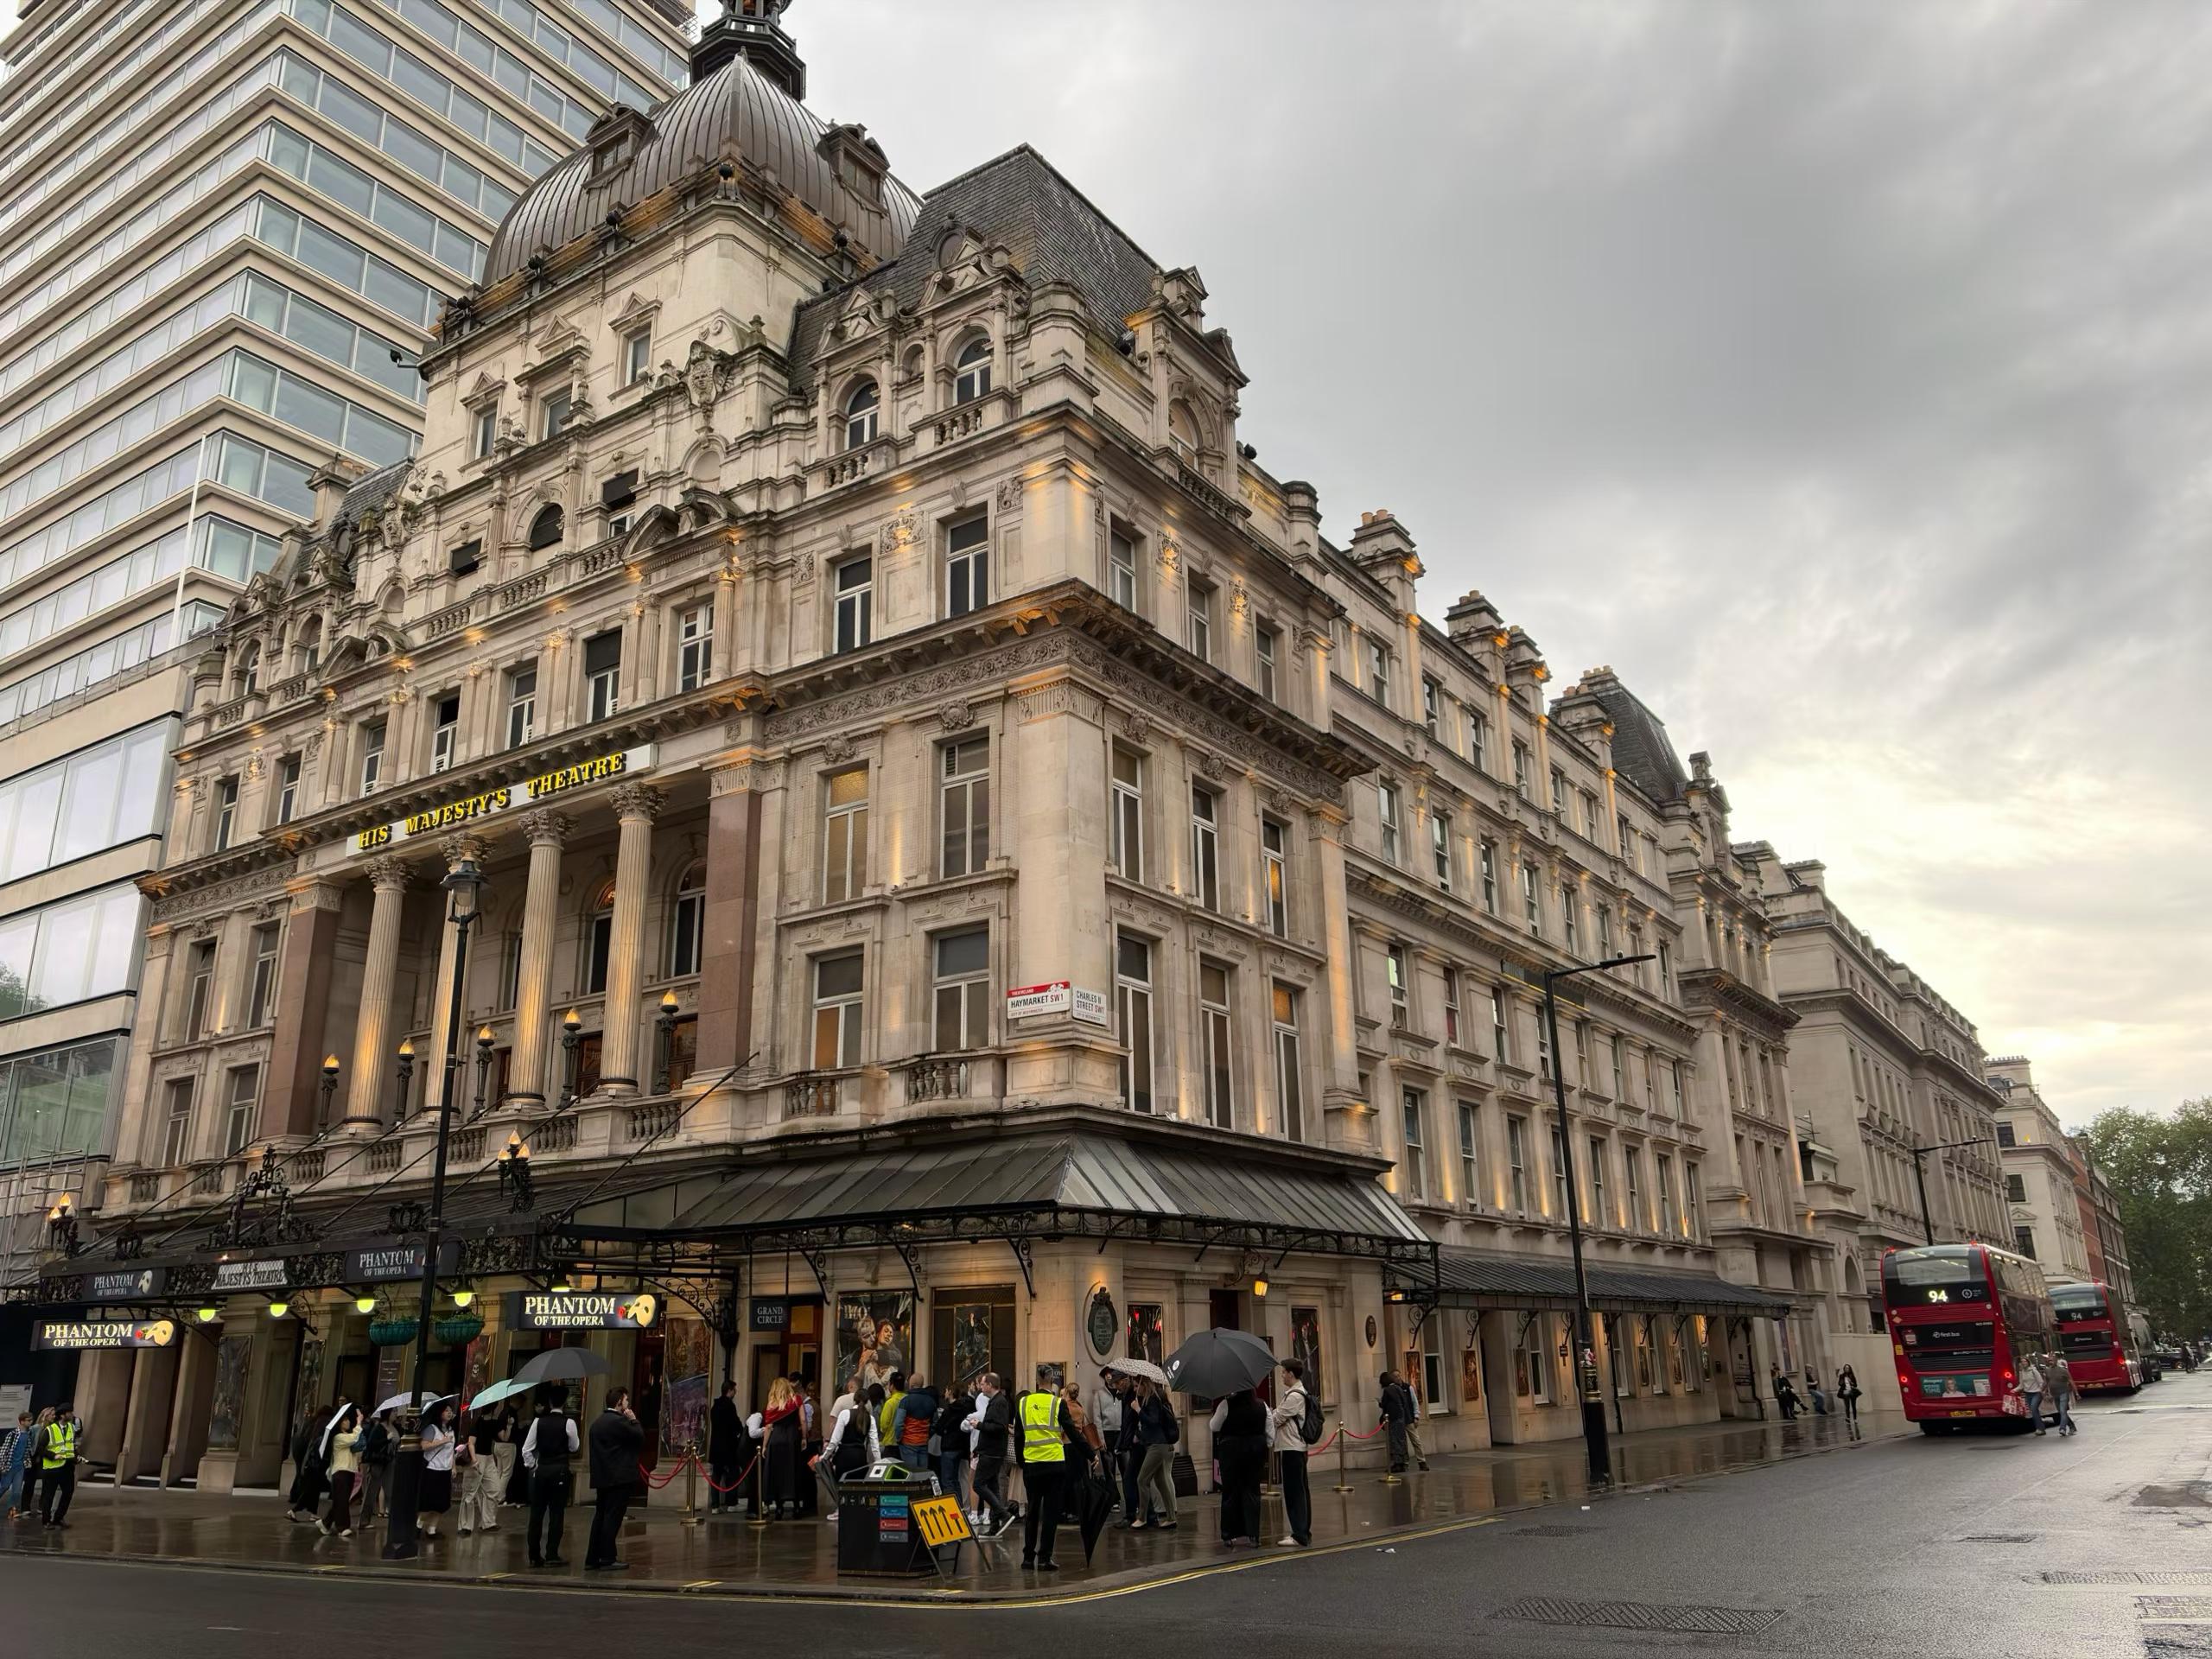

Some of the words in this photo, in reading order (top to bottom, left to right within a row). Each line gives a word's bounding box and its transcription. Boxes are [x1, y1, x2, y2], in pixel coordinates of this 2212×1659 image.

[359, 826, 391, 849] HIS
[404, 788, 511, 835] MAJESTY'S
[526, 753, 626, 798] THEATRE
[1011, 995, 1048, 1008] HAYMARKET
[1050, 994, 1064, 1003] SW1
[1077, 990, 1097, 1003] CHARLES
[1077, 1000, 1094, 1012] STREET
[1094, 1005, 1104, 1015] SW1
[359, 1249, 415, 1268] PHANTOM
[252, 1269, 286, 1285] THEATRE
[364, 1268, 373, 1277] OF
[374, 1267, 385, 1275] THE
[94, 1274, 134, 1289] PHANTOM
[1928, 1289, 1948, 1303] 94
[524, 1296, 616, 1314] PHANTOM
[757, 1306, 783, 1315] GRAND
[534, 1315, 549, 1326] OF
[550, 1315, 572, 1325] THE
[572, 1315, 604, 1325] OPERA
[757, 1315, 783, 1324] CIRCLE
[2071, 1313, 2082, 1321] 94
[43, 1324, 134, 1338] PHANTOM
[53, 1338, 67, 1347] OF
